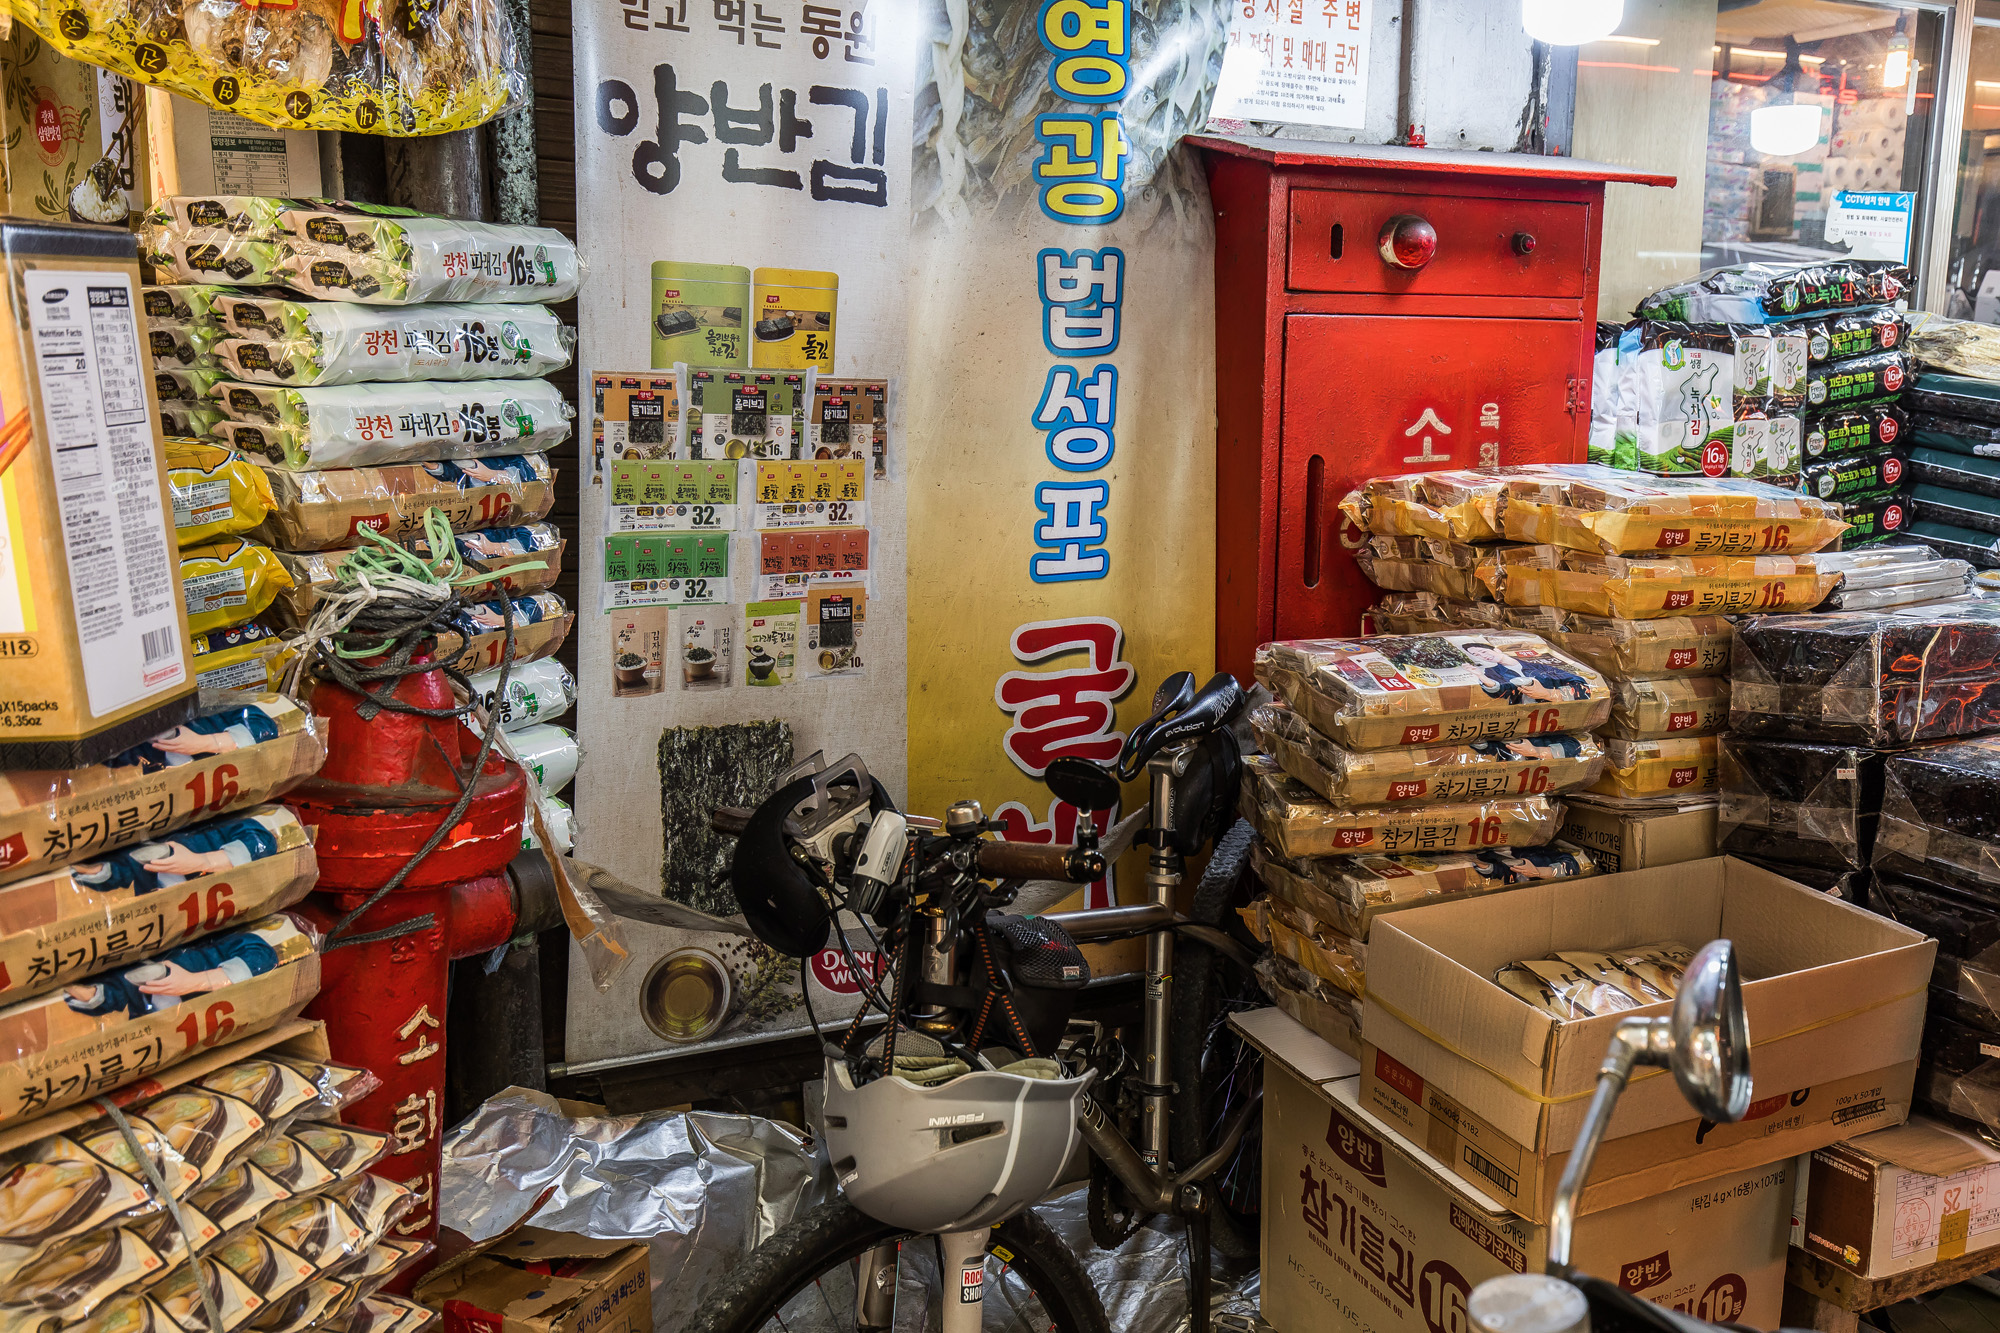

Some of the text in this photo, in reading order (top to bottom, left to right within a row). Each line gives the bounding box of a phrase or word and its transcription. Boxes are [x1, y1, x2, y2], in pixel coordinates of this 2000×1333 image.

[1322, 0, 1361, 31] 주변
[1283, 37, 1359, 76] 및 매대 금지
[596, 63, 888, 208] 양반김
[443, 252, 468, 278] 광천
[470, 252, 501, 276] 파래김
[1818, 281, 1854, 304] 녹차김
[66, 329, 82, 337] Facts
[365, 330, 398, 356] 광천
[801, 334, 829, 360] 돌김
[75, 359, 86, 370] 20
[1690, 359, 1701, 370] 성경
[735, 398, 764, 411] 올리브김
[1033, 249, 1122, 580] 법성포
[1690, 387, 1701, 436] 녹차김
[356, 415, 394, 441] 광천
[399, 412, 451, 438] 파래김
[1706, 447, 1725, 463] 16봉
[1665, 532, 1684, 545] 양반
[1761, 525, 1790, 552] 16
[1671, 594, 1689, 607] 양반
[1761, 581, 1785, 609] 16
[722, 627, 730, 657] 김자반
[1673, 652, 1691, 664] 양반
[1166, 722, 1205, 737] evolution
[1409, 728, 1432, 741] 양반
[1527, 709, 1560, 734] 16
[1674, 715, 1692, 728] 양반
[1396, 782, 1419, 797] 양반
[1433, 776, 1510, 799] 참기름김
[1675, 770, 1693, 783] 양반
[185, 763, 240, 819] 16
[1341, 816, 1510, 850] 양반 참기름김 16봉
[178, 883, 236, 938] 16
[176, 1000, 236, 1057] 16
[1390, 1097, 1409, 1118] 예다원
[1835, 1086, 1882, 1106] 100g 50개입
[1428, 1096, 1479, 1137] 070-4082-4182
[1337, 1124, 1375, 1171] 양반
[1301, 1143, 1416, 1246] 좋은 원초에 참기름향이 고소한
[1300, 1163, 1415, 1309] 참기름김
[1451, 1205, 1524, 1274] 건해산물가공식품
[1334, 1253, 1351, 1274] LAVER
[1353, 1268, 1369, 1290] WITH
[1369, 1285, 1392, 1310] SESAME
[1393, 1302, 1404, 1319] OIL
[1626, 1259, 1661, 1287] 양반
[1674, 1284, 1696, 1299] 고소한
